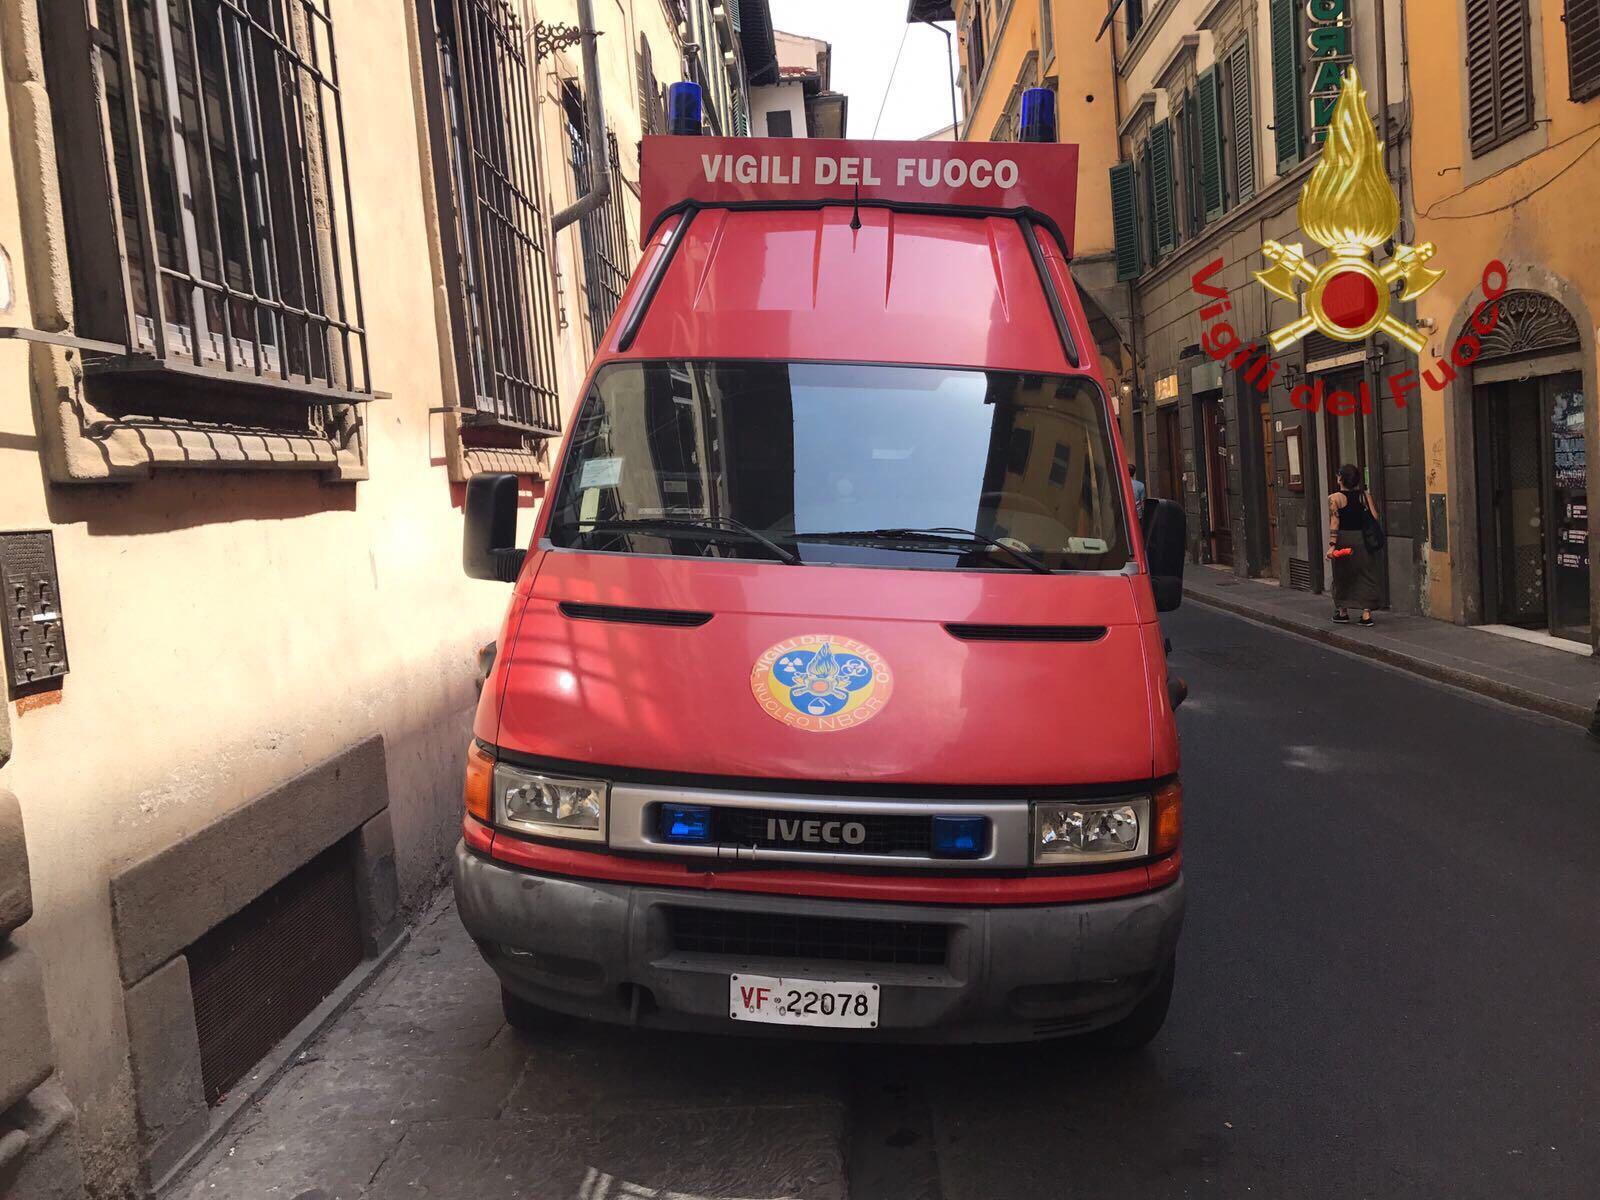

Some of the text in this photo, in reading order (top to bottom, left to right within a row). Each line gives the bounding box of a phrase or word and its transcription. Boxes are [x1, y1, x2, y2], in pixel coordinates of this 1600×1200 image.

[701, 154, 1019, 189] VIGILI DEL FUOCO
[756, 634, 890, 684] VIGILI DEL FUOCO
[754, 682, 810, 727] NUCLEO
[766, 818, 866, 844] IVECO
[740, 986, 868, 1017] VF 22078
